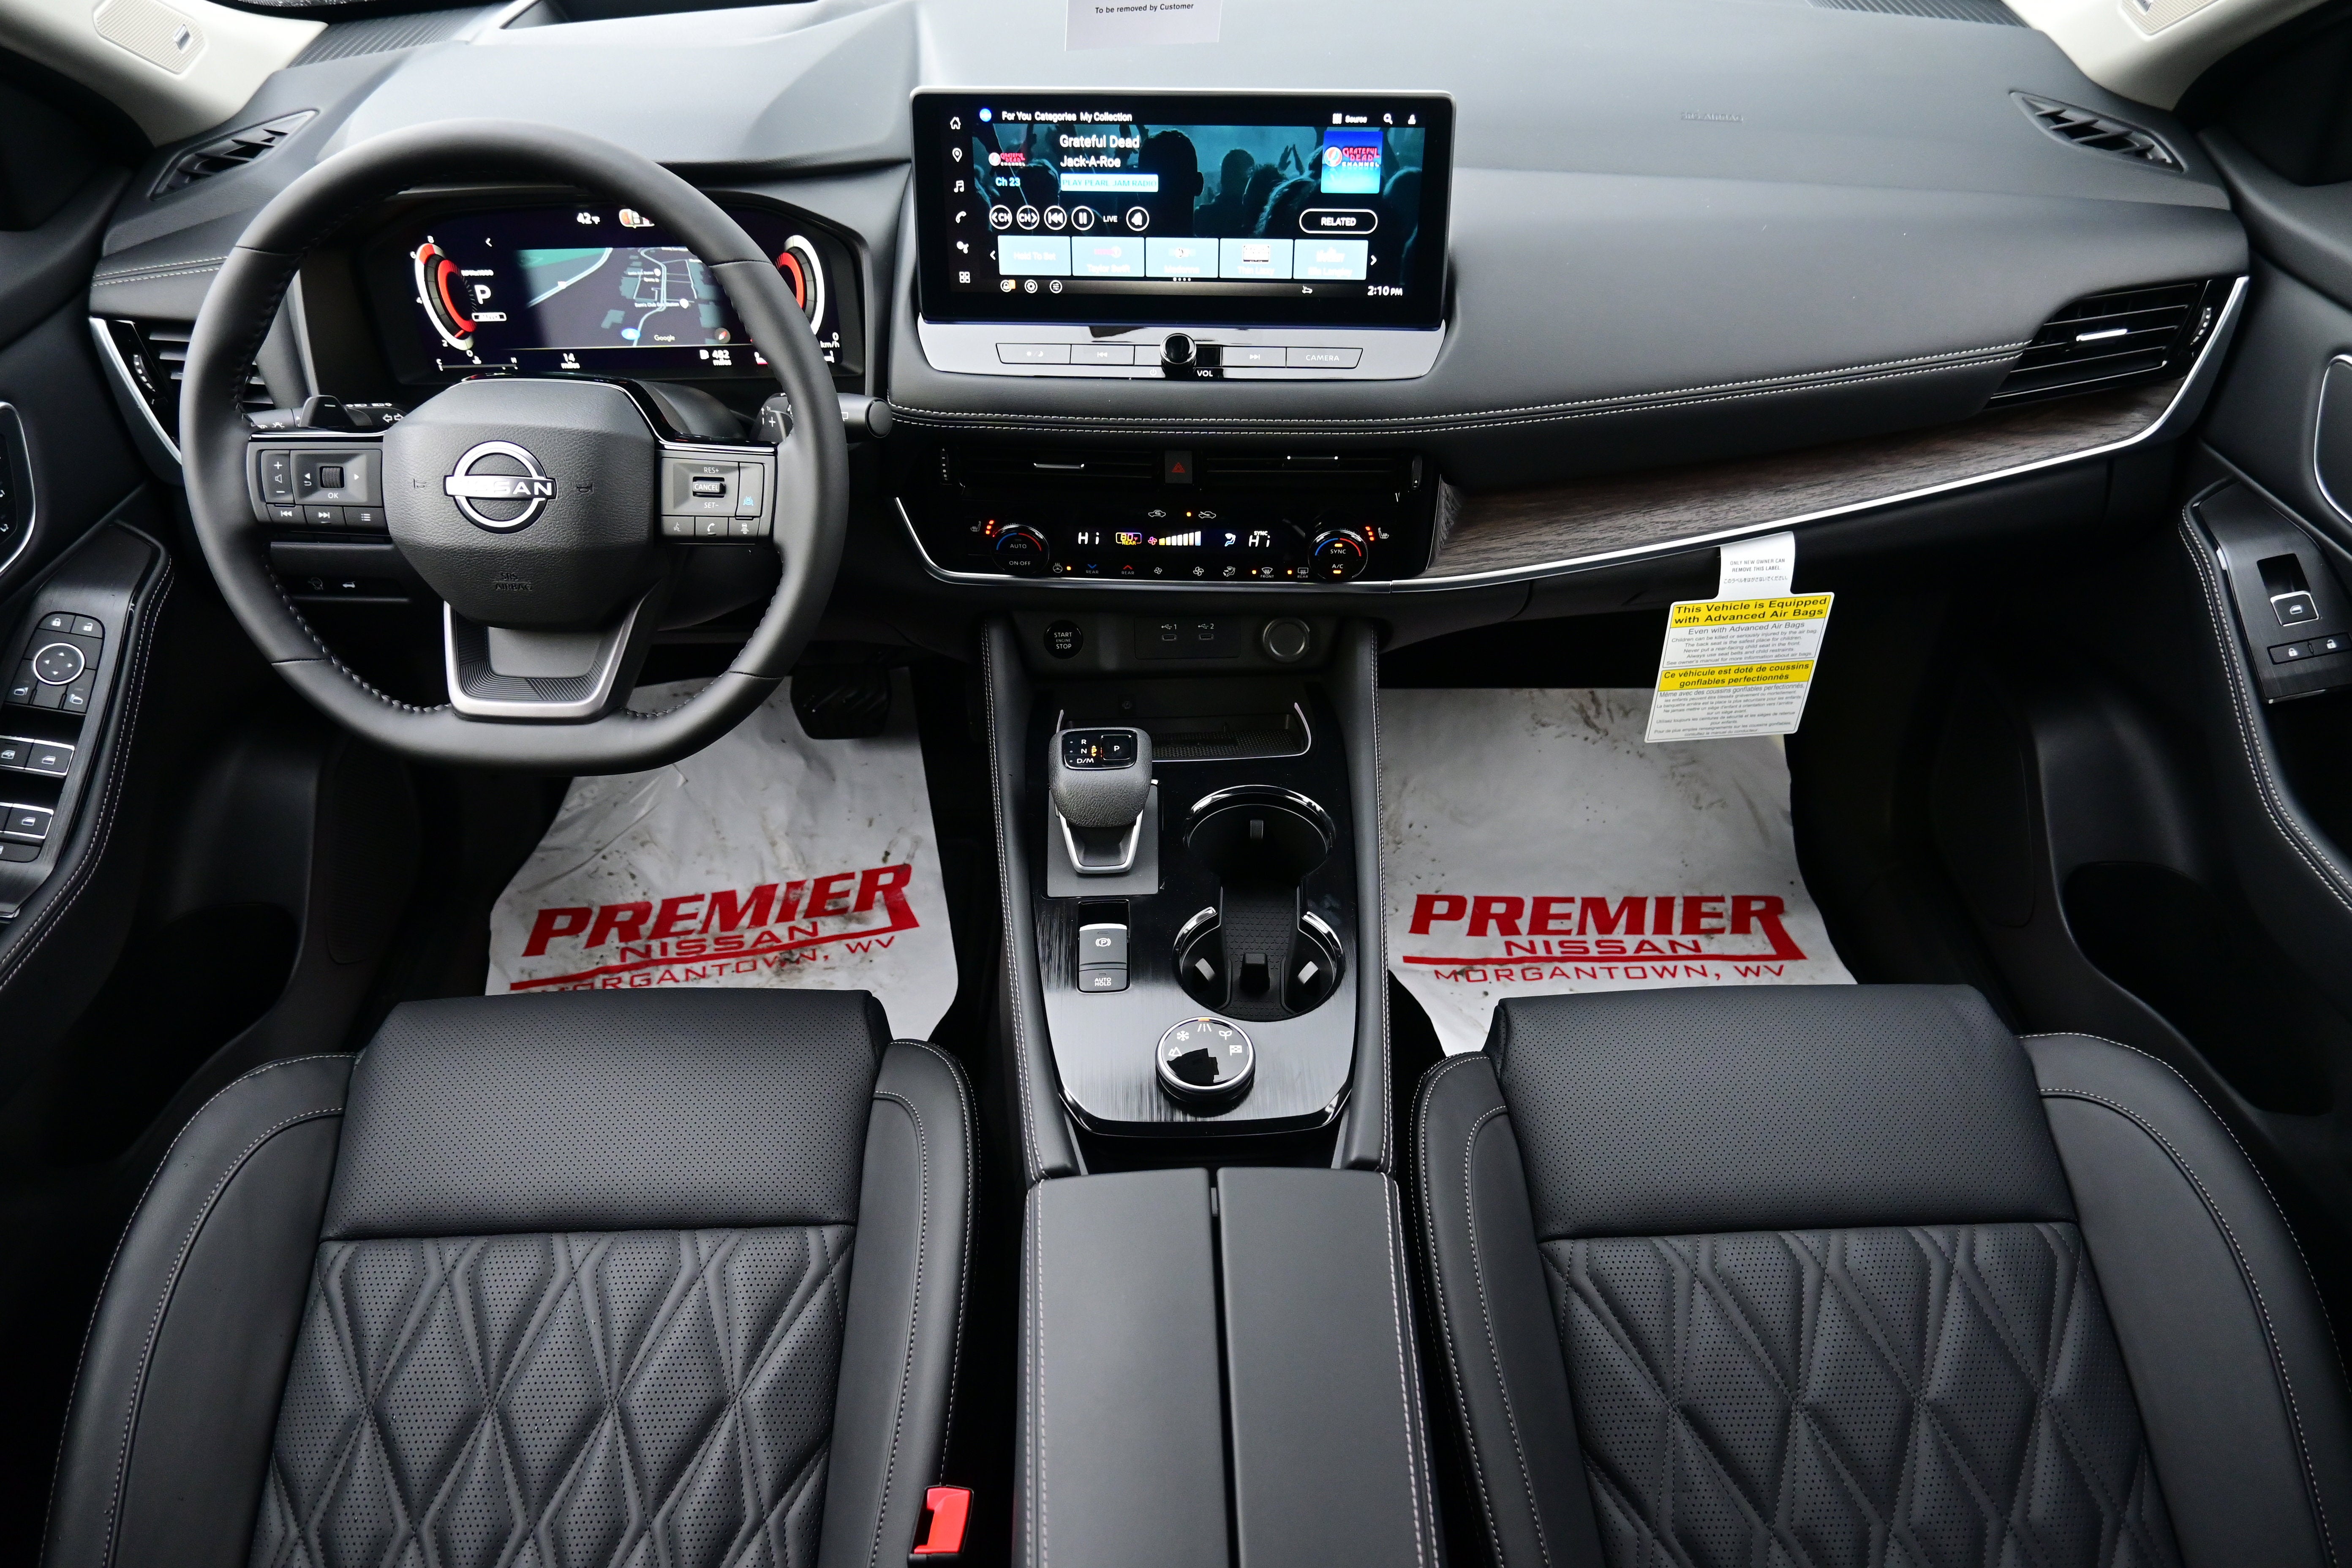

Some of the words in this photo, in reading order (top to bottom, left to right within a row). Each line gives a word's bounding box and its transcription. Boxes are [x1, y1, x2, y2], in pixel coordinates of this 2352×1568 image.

[1002, 112, 1015, 120] For
[1016, 112, 1032, 120] You
[1034, 112, 1077, 122] Categories
[1080, 112, 1092, 122] My
[1093, 112, 1132, 122] Collection
[1059, 134, 1106, 148] Grateful
[1110, 135, 1140, 148] Dead
[1342, 147, 1380, 158] GRATEFUL
[1060, 155, 1121, 168] Jack-A-Roe
[995, 177, 1008, 186] Ch
[1009, 177, 1021, 186] 23
[998, 214, 1010, 222] CH
[1018, 214, 1031, 222] CH
[1321, 217, 1356, 226] RELATED
[410, 251, 416, 259] 6
[474, 284, 491, 304] P
[1368, 286, 1389, 296] 2:10
[654, 334, 675, 342] Google
[832, 332, 839, 341] 0
[563, 353, 575, 362] 14
[712, 350, 730, 359] 482
[1676, 605, 1702, 614] This
[1705, 602, 1750, 612] Vehicle
[1768, 597, 1827, 609] Equipped
[1674, 615, 1700, 624] with
[1704, 611, 1765, 622] Advanced
[1769, 610, 1788, 618] Air
[1792, 607, 1824, 618] Bags
[1729, 623, 1769, 632] Advanced
[1784, 621, 1805, 629] Bags
[1678, 668, 1715, 677] véhicule
[1734, 666, 1753, 674] doté
[1769, 662, 1810, 671] coussins
[1679, 677, 1726, 688] gonflables
[1728, 672, 1790, 685] perfectionnés
[1732, 686, 1763, 694] gonflables
[1763, 683, 1805, 691] perfectionnés,
[522, 864, 920, 957] PREMIER
[1409, 894, 1807, 960] PREMIER
[621, 922, 819, 963] NISSAN
[1504, 939, 1702, 957] NISSAN
[541, 949, 829, 992] RGANTOWN,
[845, 936, 895, 954] WV
[1434, 964, 1721, 983] MORGANTOWN,
[1734, 964, 1784, 978] WV
